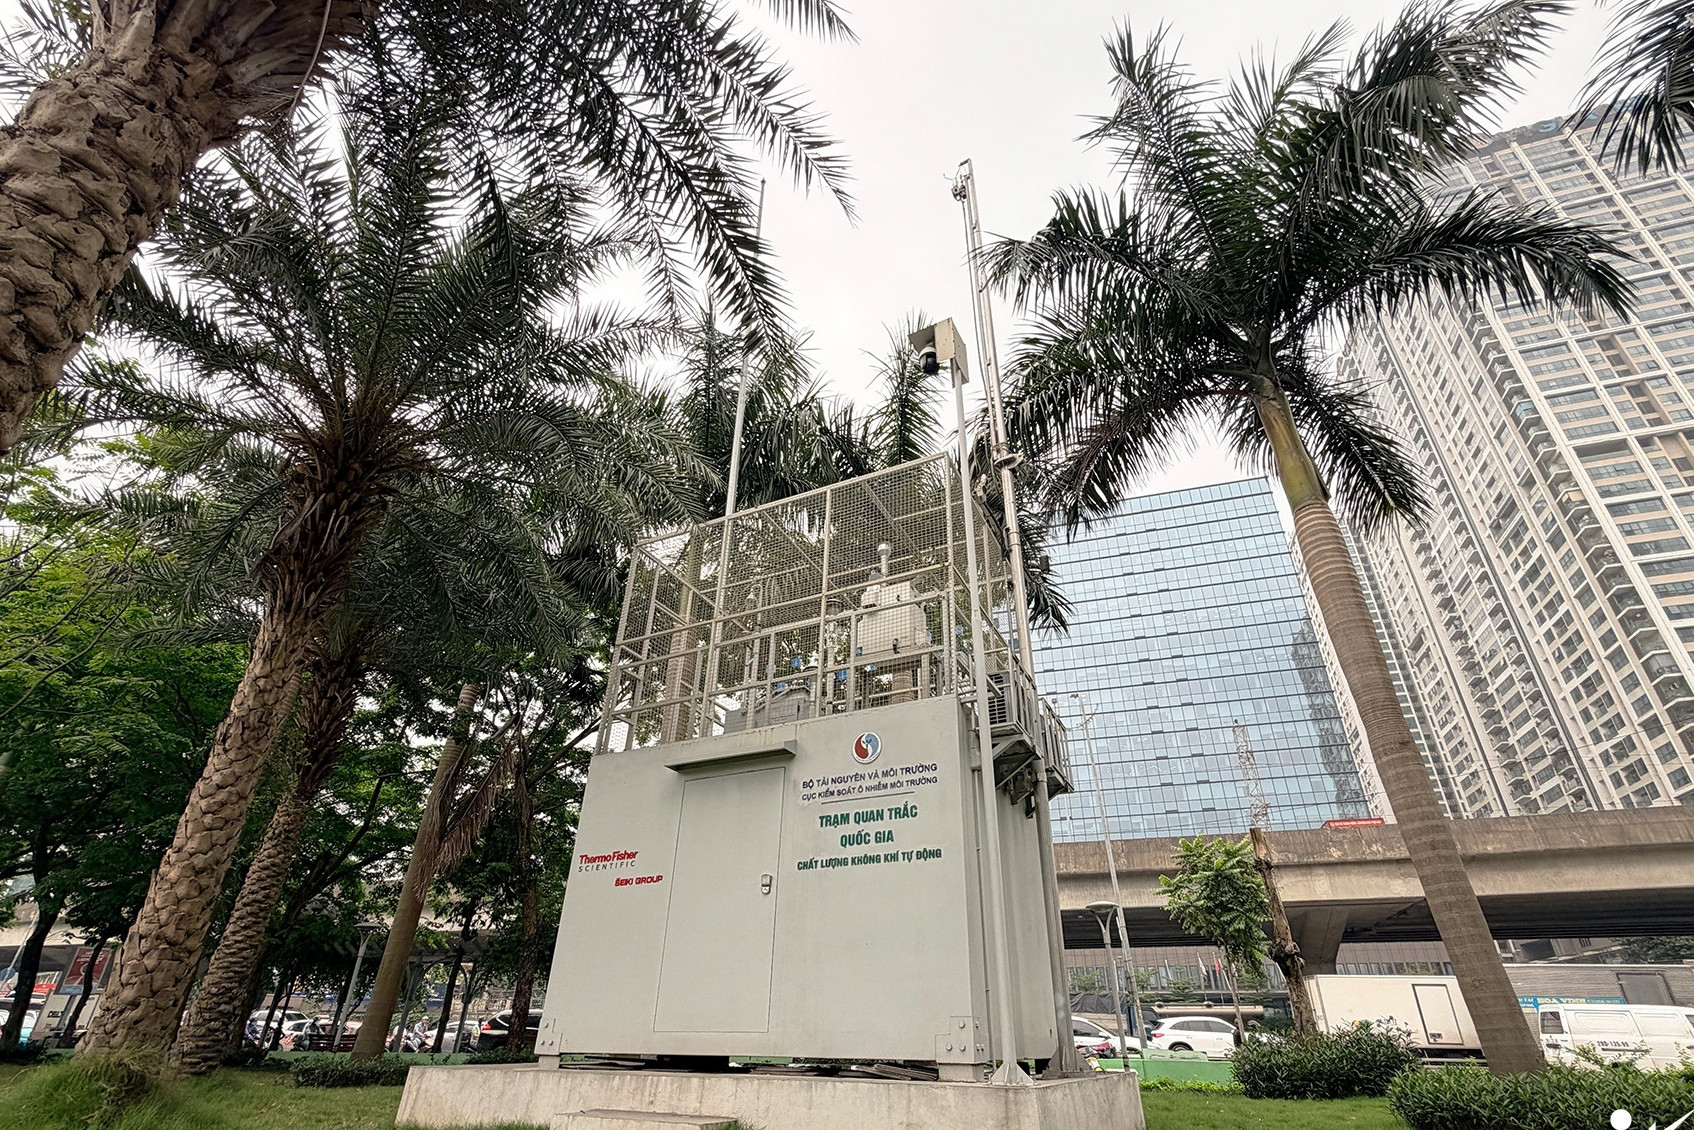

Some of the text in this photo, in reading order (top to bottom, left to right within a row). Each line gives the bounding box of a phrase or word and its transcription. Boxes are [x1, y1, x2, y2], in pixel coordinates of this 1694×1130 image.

[802, 763, 938, 790] BỘ TÀI NGUYÊN VÀ MÔI TRƯỜNG
[801, 792, 817, 802] CỤC
[836, 786, 856, 796] SOÁT
[857, 784, 864, 793] Ô
[889, 779, 904, 789] MÔI
[905, 775, 938, 787] TRƯỜNG
[819, 801, 918, 828] TRẠM QUAN TRẮC
[840, 829, 894, 848] QUỐC GIA
[578, 860, 636, 872] SCIENTIFIC
[797, 848, 942, 870] CHẤT LƯỢNG KHÔNG KHÍ TỰ ĐỘNG
[635, 875, 663, 885] GROUP
